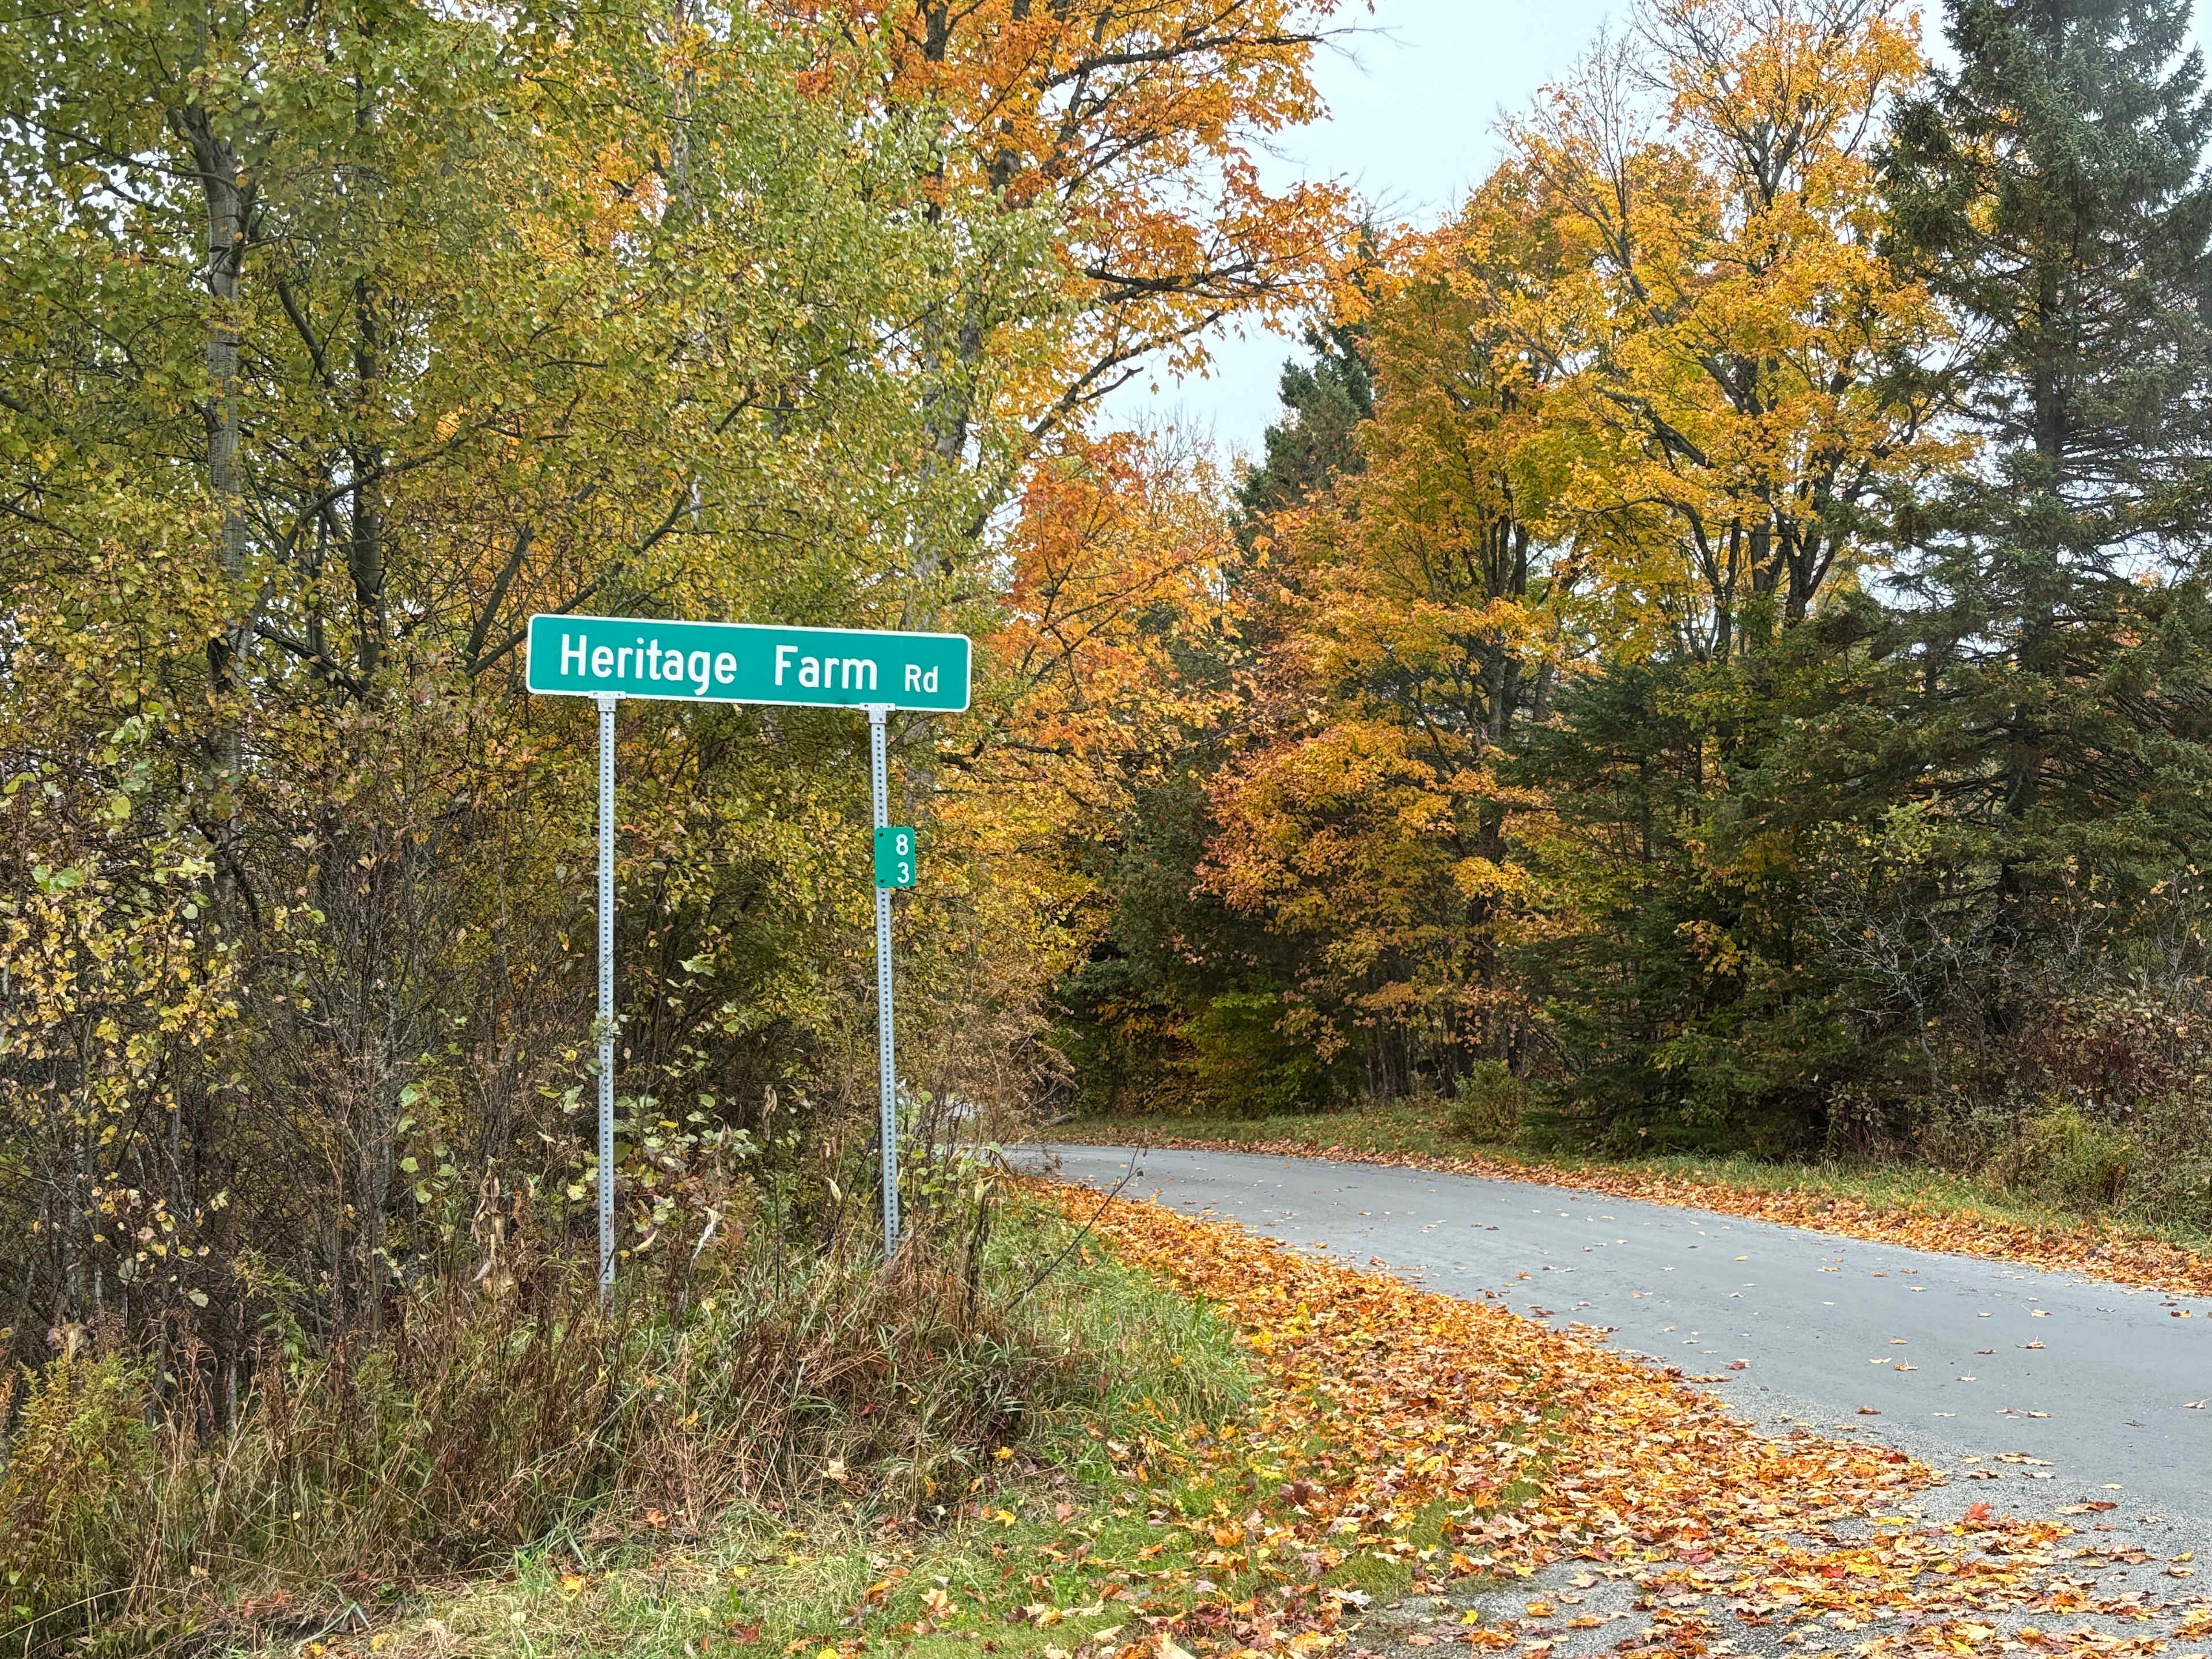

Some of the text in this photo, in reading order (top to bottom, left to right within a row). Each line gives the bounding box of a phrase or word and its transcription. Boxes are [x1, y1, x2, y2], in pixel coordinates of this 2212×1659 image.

[560, 633, 939, 696] Heritage Farm Rd
